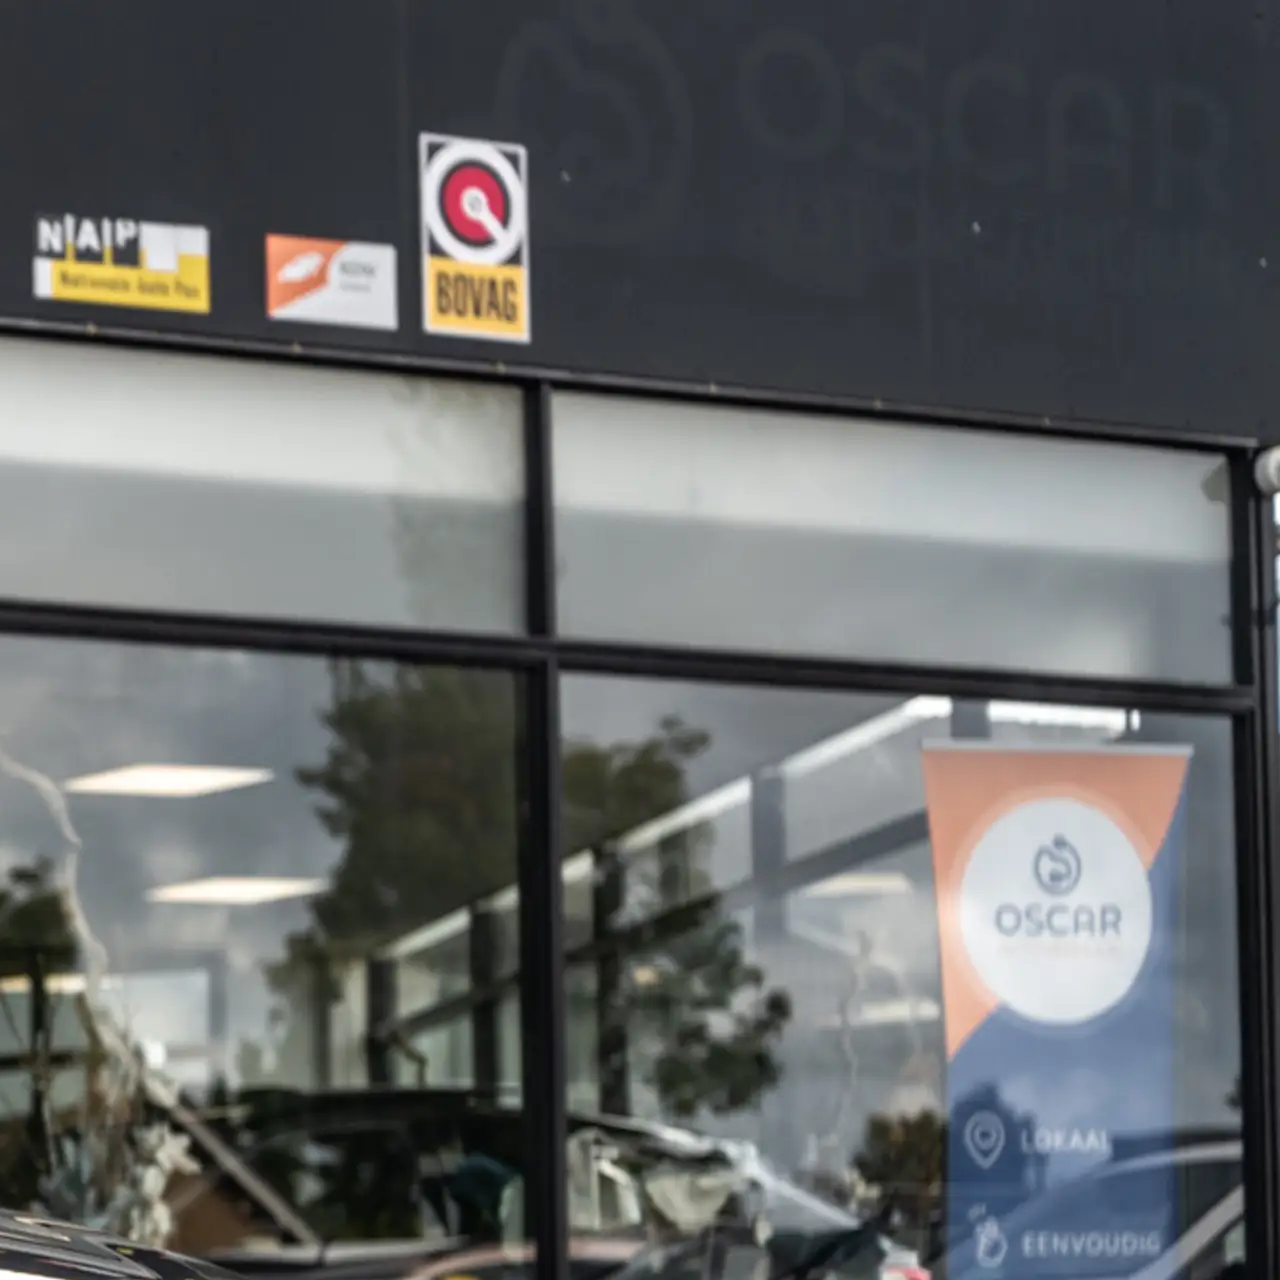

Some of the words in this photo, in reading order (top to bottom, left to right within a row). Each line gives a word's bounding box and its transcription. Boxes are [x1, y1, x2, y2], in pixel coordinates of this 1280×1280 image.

[435, 271, 518, 323] BOVAG
[994, 902, 1123, 938] OSCAR
[1020, 1127, 1111, 1155] LOKAAL
[1022, 1230, 1162, 1258] EENVOUDIG
